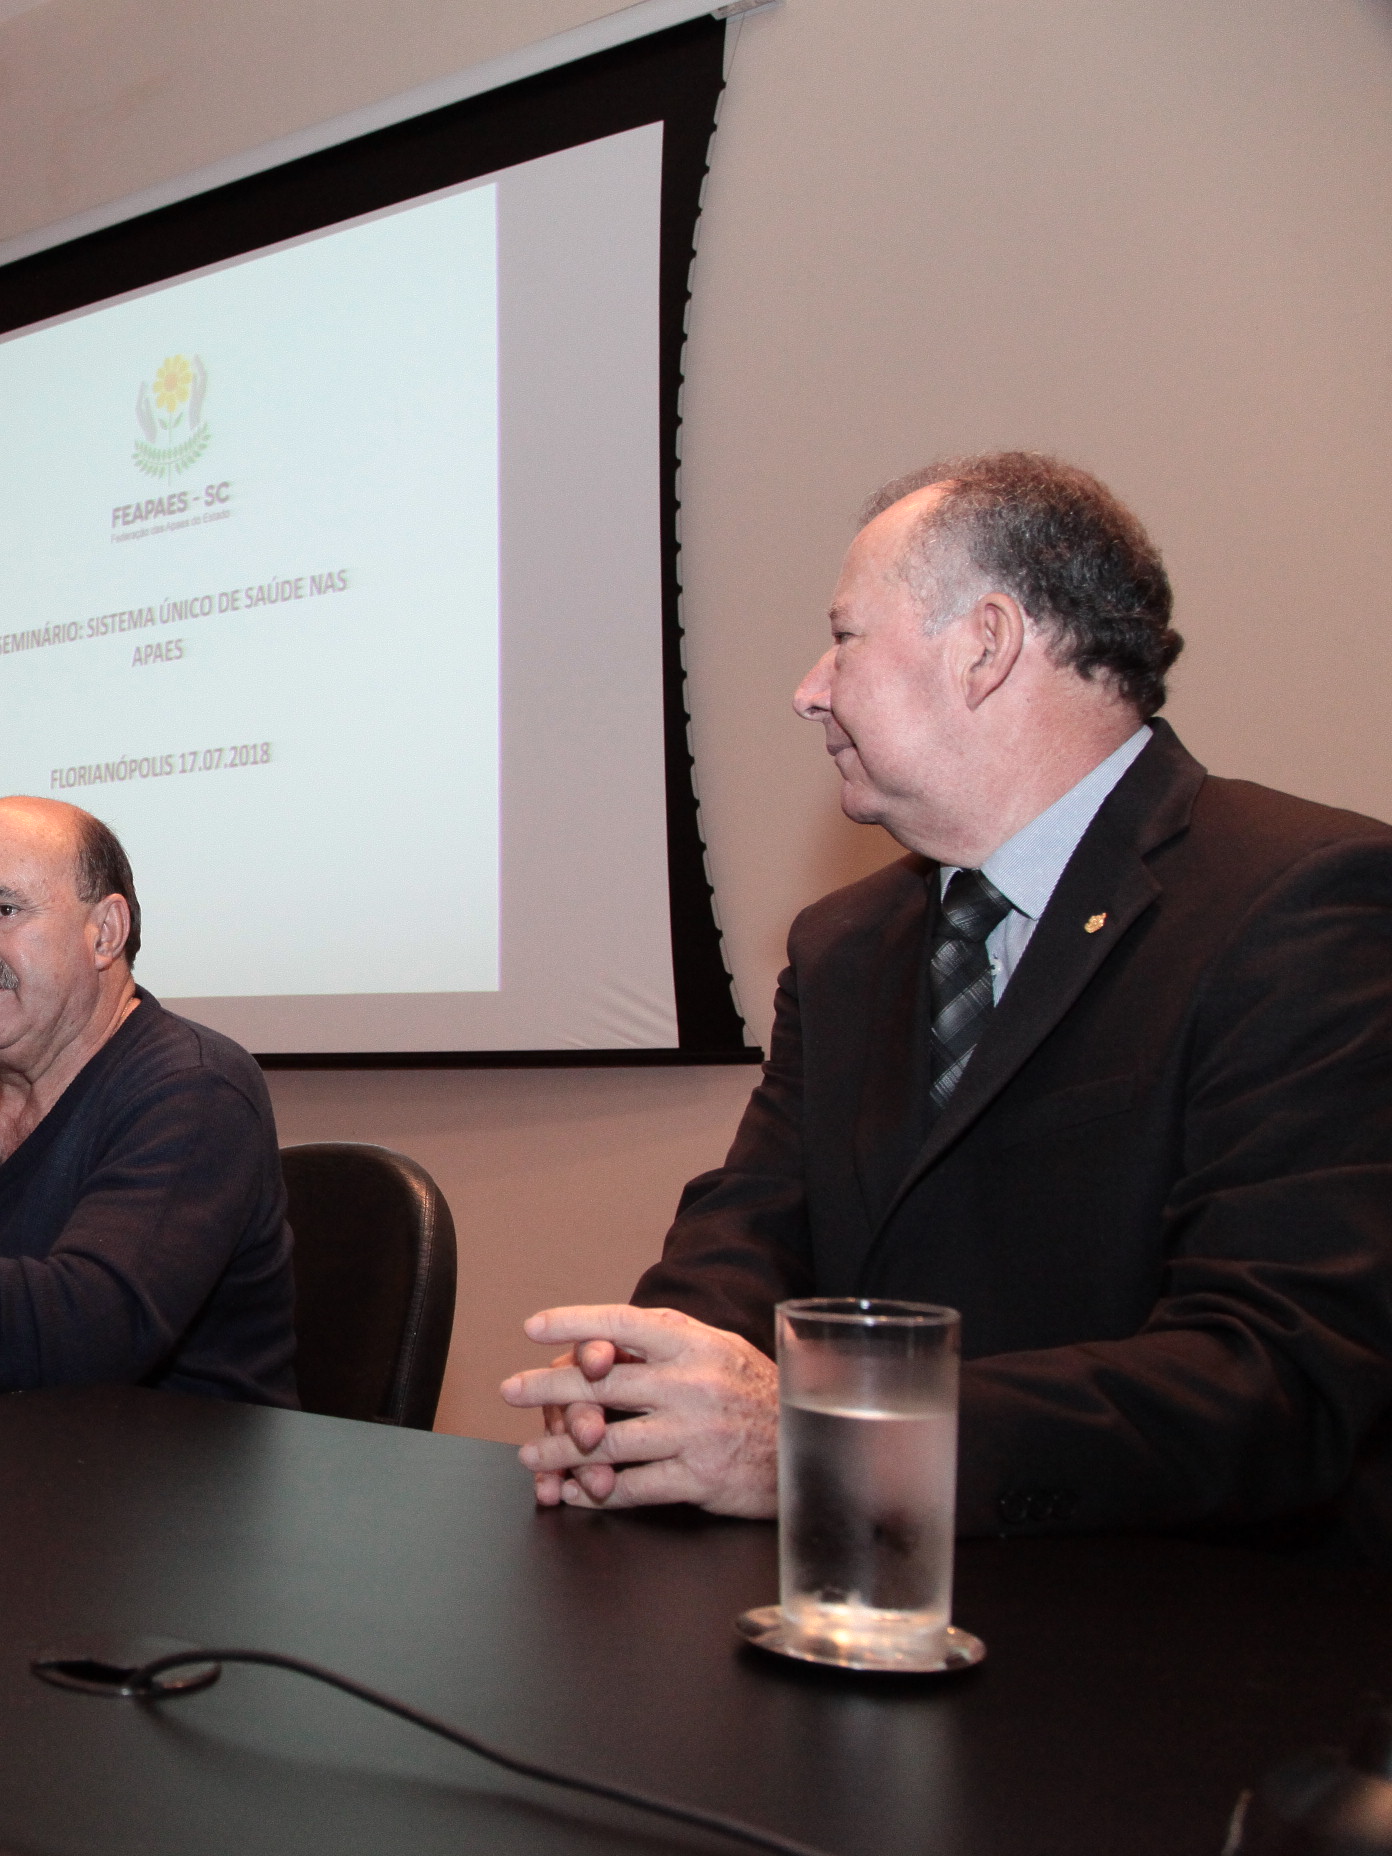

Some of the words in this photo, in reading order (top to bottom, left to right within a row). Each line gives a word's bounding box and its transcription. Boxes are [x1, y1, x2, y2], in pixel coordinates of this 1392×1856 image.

[111, 491, 188, 528] FEAPAES
[204, 481, 230, 507] SC
[86, 607, 156, 638] SISTEMA
[159, 597, 213, 624] ÚNICO
[218, 589, 240, 613] DE
[244, 576, 304, 609] SAÚDE
[309, 569, 347, 597] NAS
[132, 639, 184, 667] APAES
[50, 755, 174, 789] FLORIANÓPOLIS
[178, 742, 271, 774] 17.07.2018
